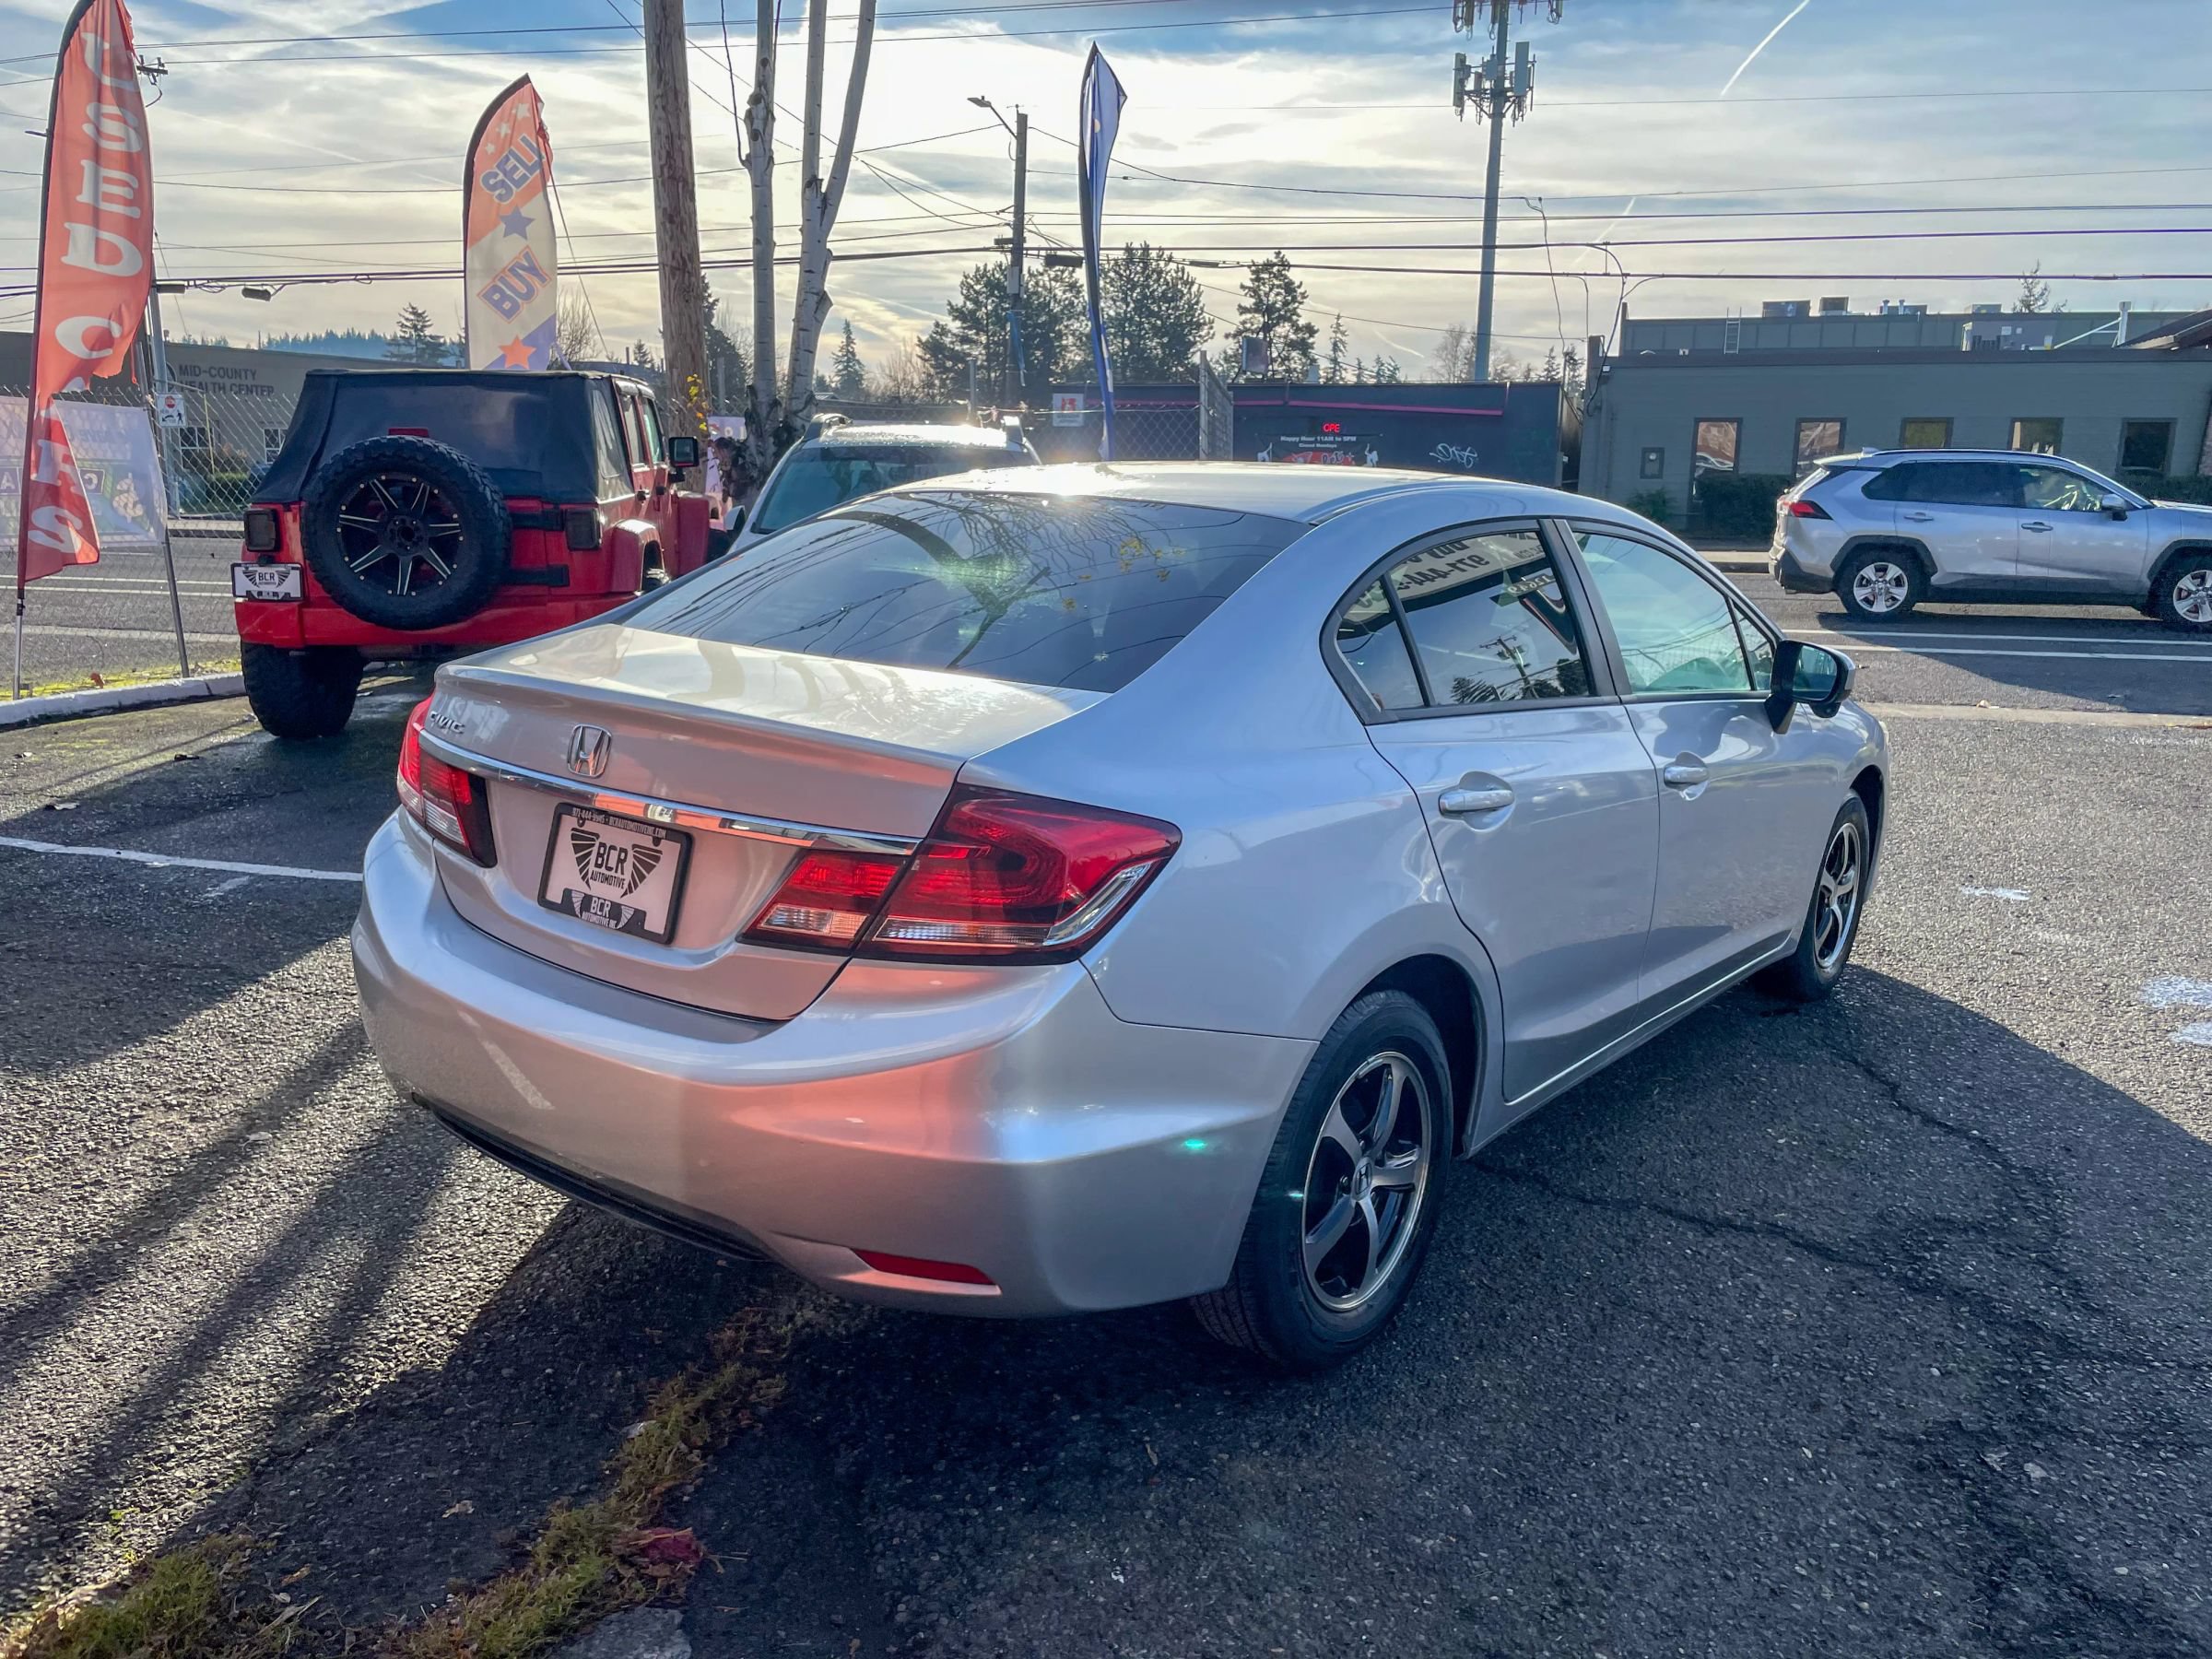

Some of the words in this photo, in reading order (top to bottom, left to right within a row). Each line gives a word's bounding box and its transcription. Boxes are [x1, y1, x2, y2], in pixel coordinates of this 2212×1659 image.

[480, 134, 546, 205] SELL
[477, 246, 551, 323] BUY
[178, 364, 258, 381] MID-COUNTY
[180, 380, 226, 394] HEALTH
[229, 382, 275, 397] CENTER
[28, 315, 122, 554] CRS
[258, 571, 276, 582] BCR
[429, 711, 465, 735] CIVIC
[594, 841, 629, 876] BCR
[590, 870, 627, 889] AUTOMOTIVE
[590, 897, 612, 918] BCR
[582, 911, 610, 927] AUTOMOTIVE
